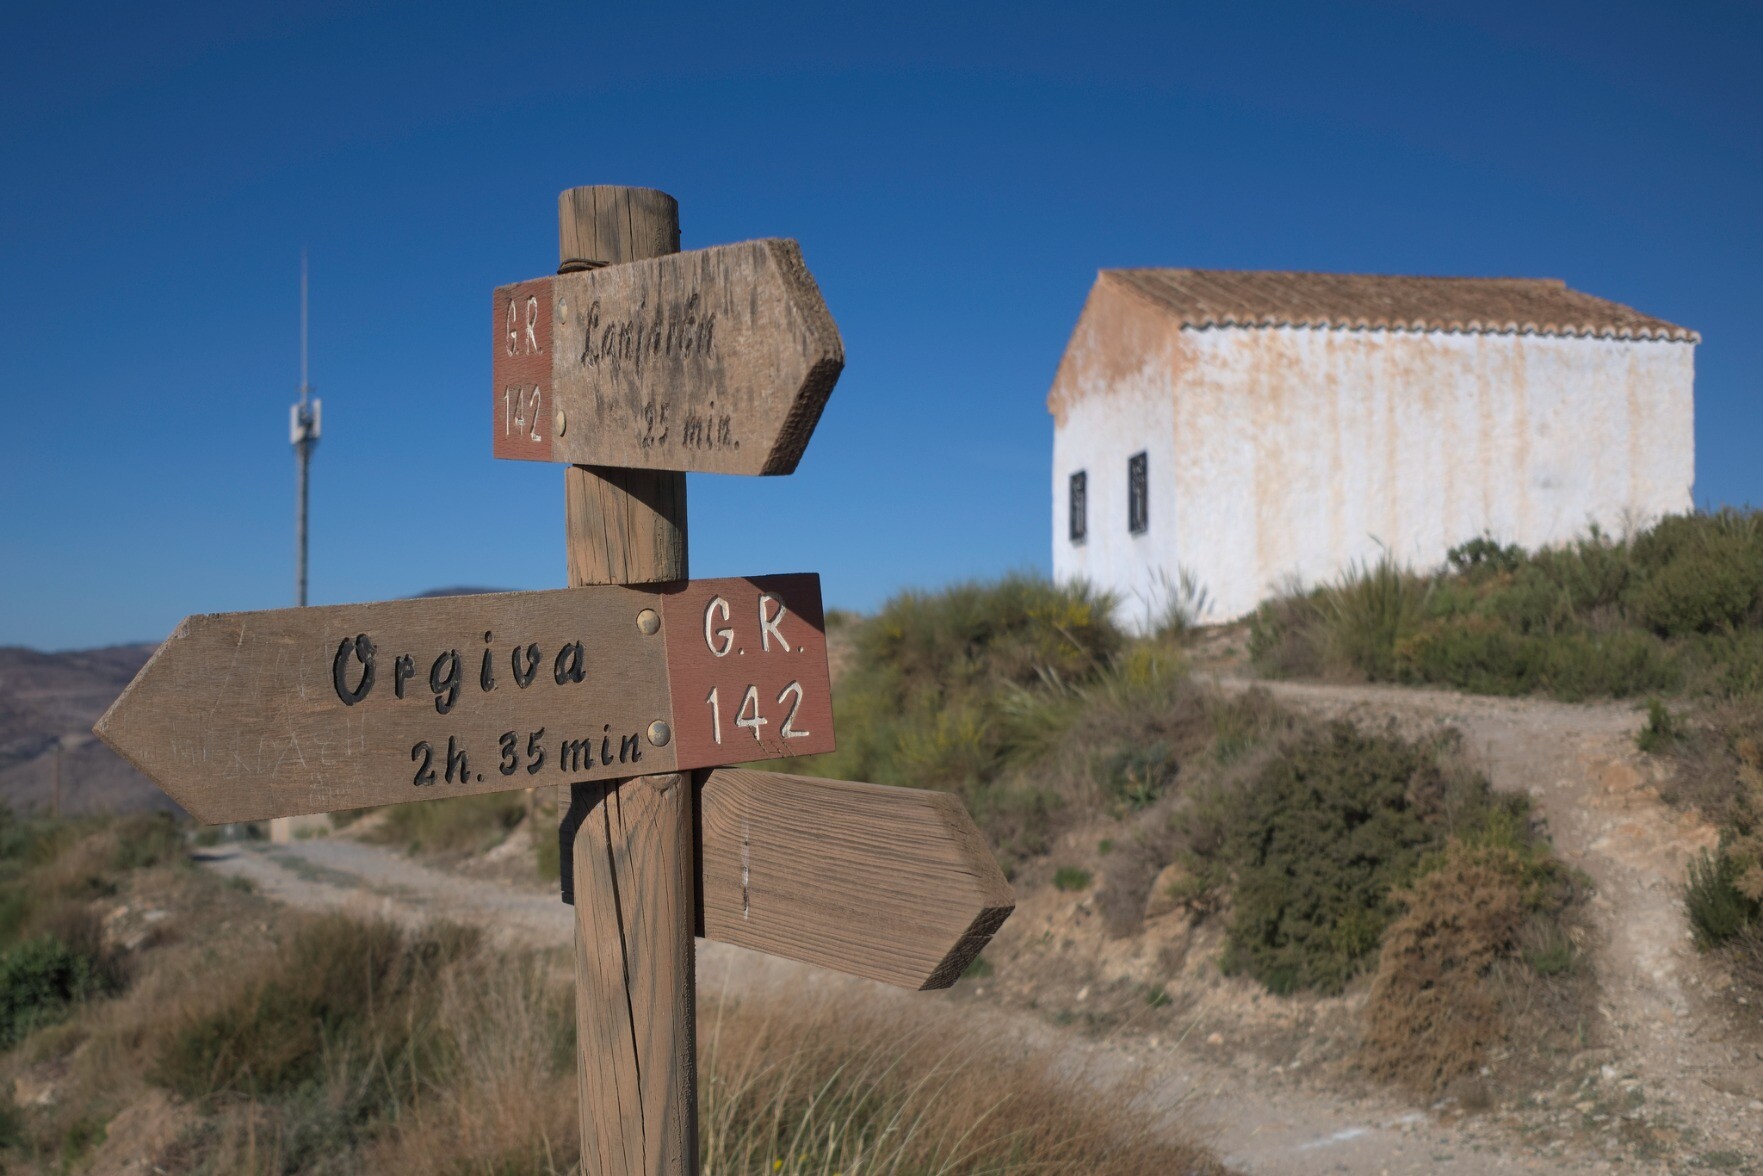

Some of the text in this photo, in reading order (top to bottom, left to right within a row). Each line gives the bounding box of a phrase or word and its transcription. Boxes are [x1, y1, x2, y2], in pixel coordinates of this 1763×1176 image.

[503, 384, 543, 442] 142
[641, 401, 741, 450] 25 min.
[333, 630, 588, 715] Orgiva
[706, 680, 810, 745] 142
[411, 723, 643, 787] 2h. 35 min
